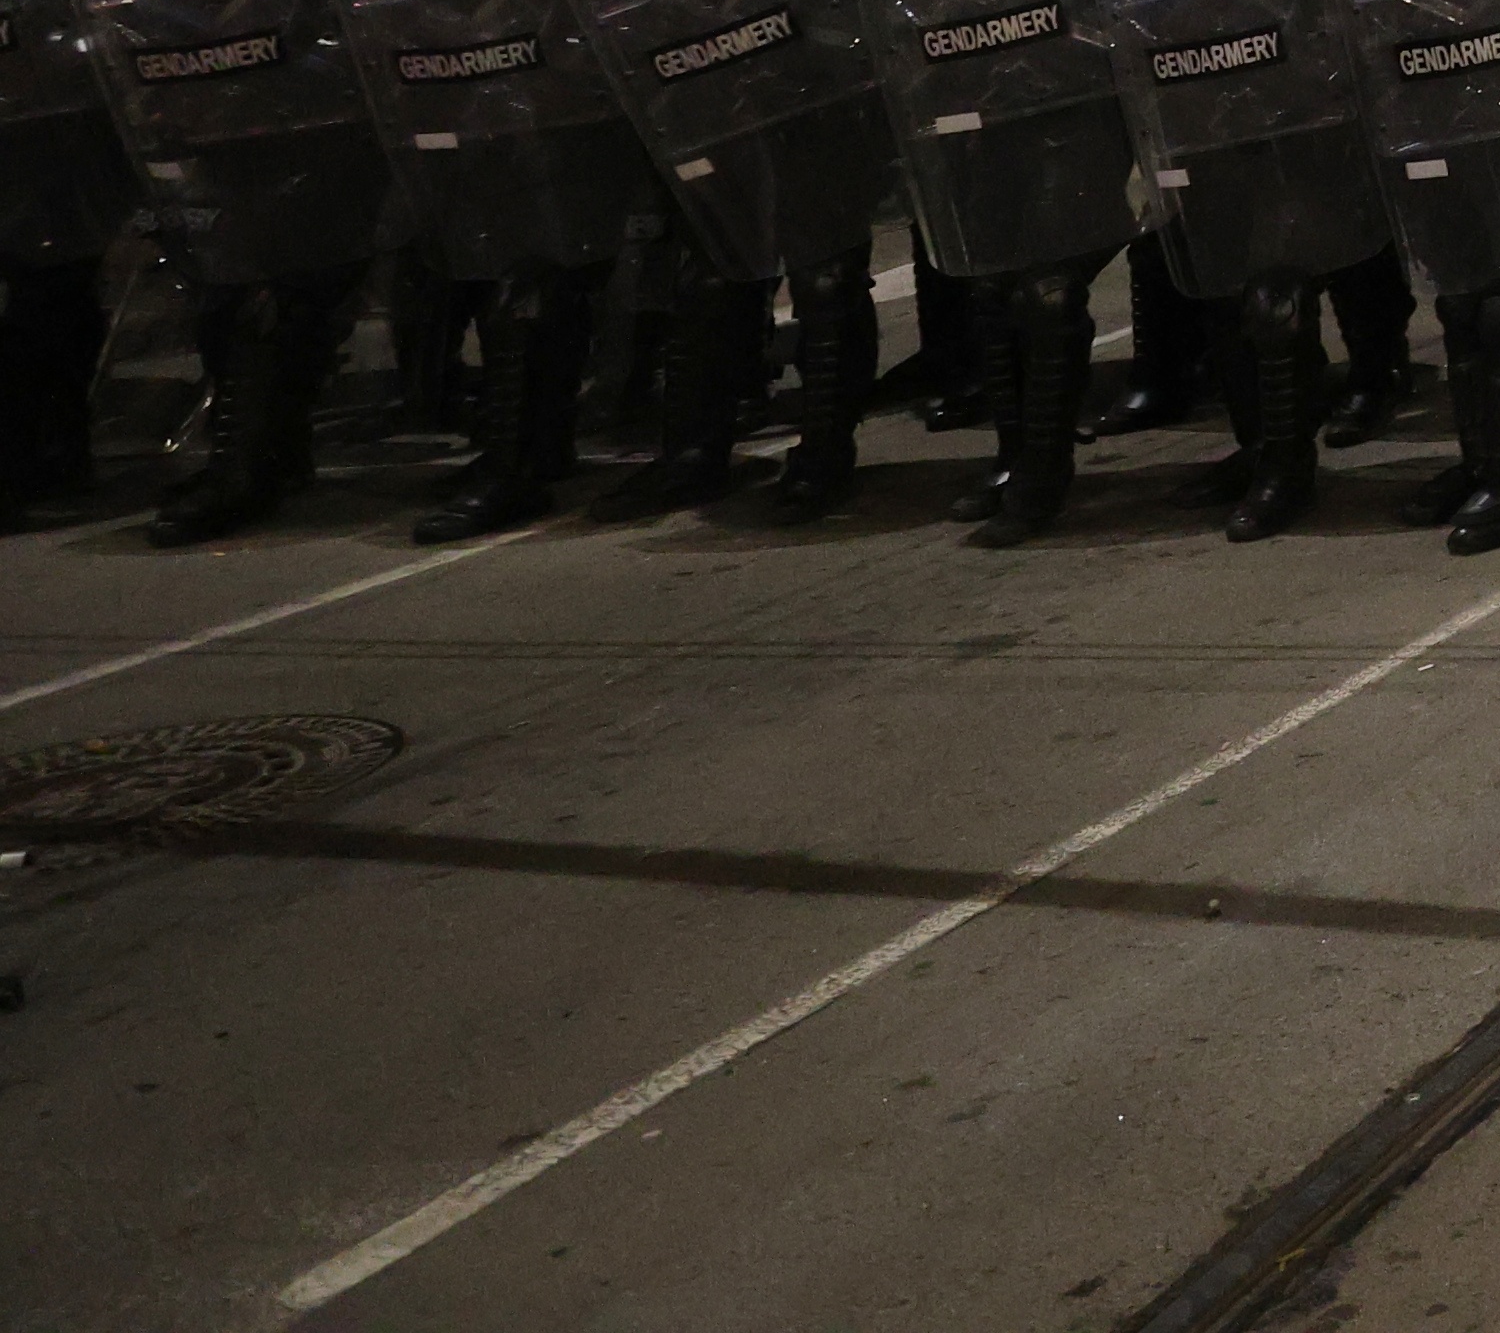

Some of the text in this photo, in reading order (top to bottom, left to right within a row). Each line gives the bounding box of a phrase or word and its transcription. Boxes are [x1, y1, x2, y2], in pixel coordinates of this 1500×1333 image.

[655, 12, 791, 77] GENDARMERY
[924, 5, 1058, 57] GENDARMERY
[136, 36, 279, 78] GENDARMERY
[399, 38, 537, 79] GENDARMERY
[1153, 33, 1279, 79] GENDARMERY
